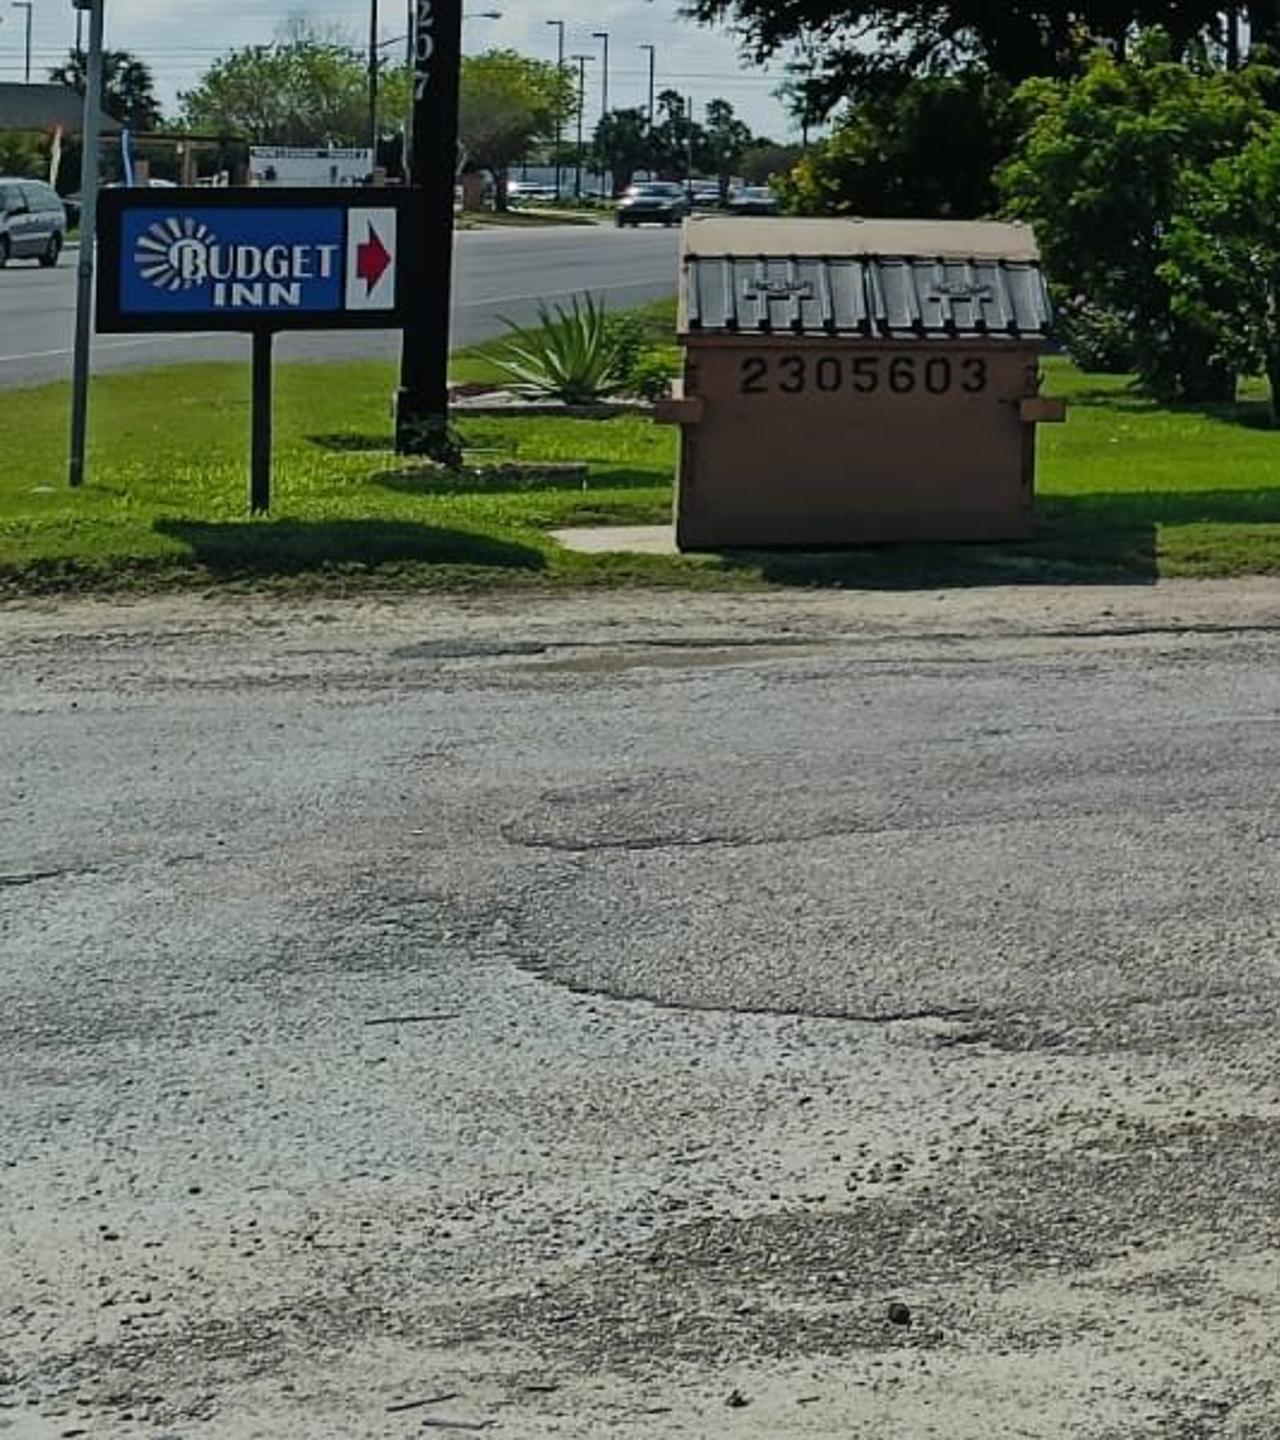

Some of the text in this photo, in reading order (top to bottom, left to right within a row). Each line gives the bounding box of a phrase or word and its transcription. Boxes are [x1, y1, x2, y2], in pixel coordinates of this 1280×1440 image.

[180, 243, 340, 280] BUDGET
[213, 282, 302, 307] INN
[740, 355, 988, 395] 2305603
